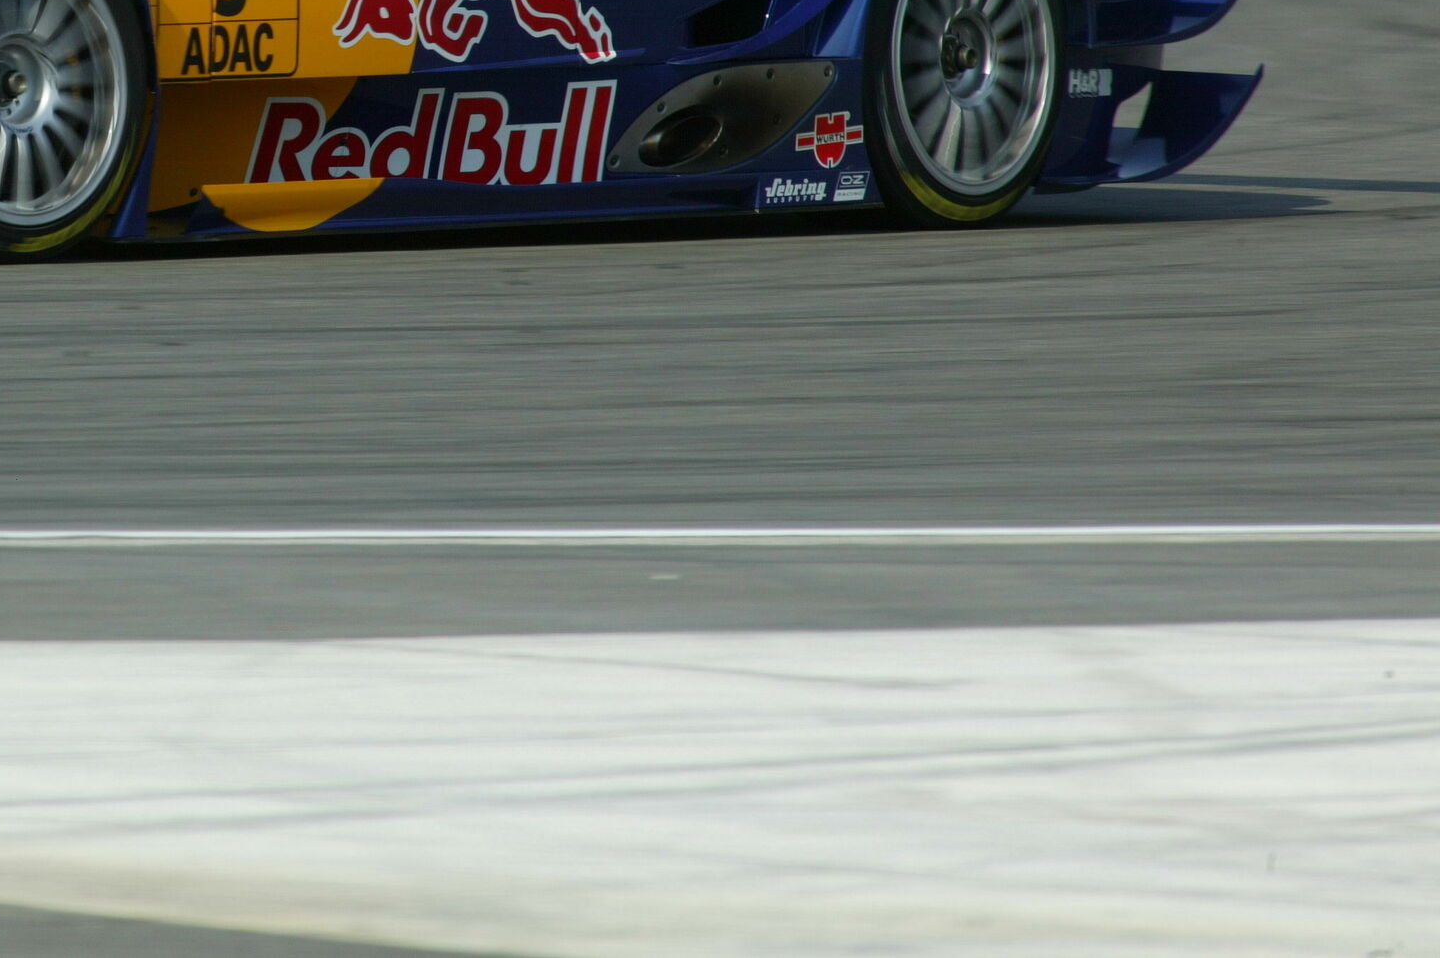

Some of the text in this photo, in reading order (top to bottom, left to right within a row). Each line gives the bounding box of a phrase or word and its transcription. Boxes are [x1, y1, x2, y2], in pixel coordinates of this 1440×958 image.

[181, 22, 274, 75] ADAC
[245, 78, 618, 186] Red Bull
[765, 178, 827, 201] Sebring
[840, 174, 865, 185] OZ
